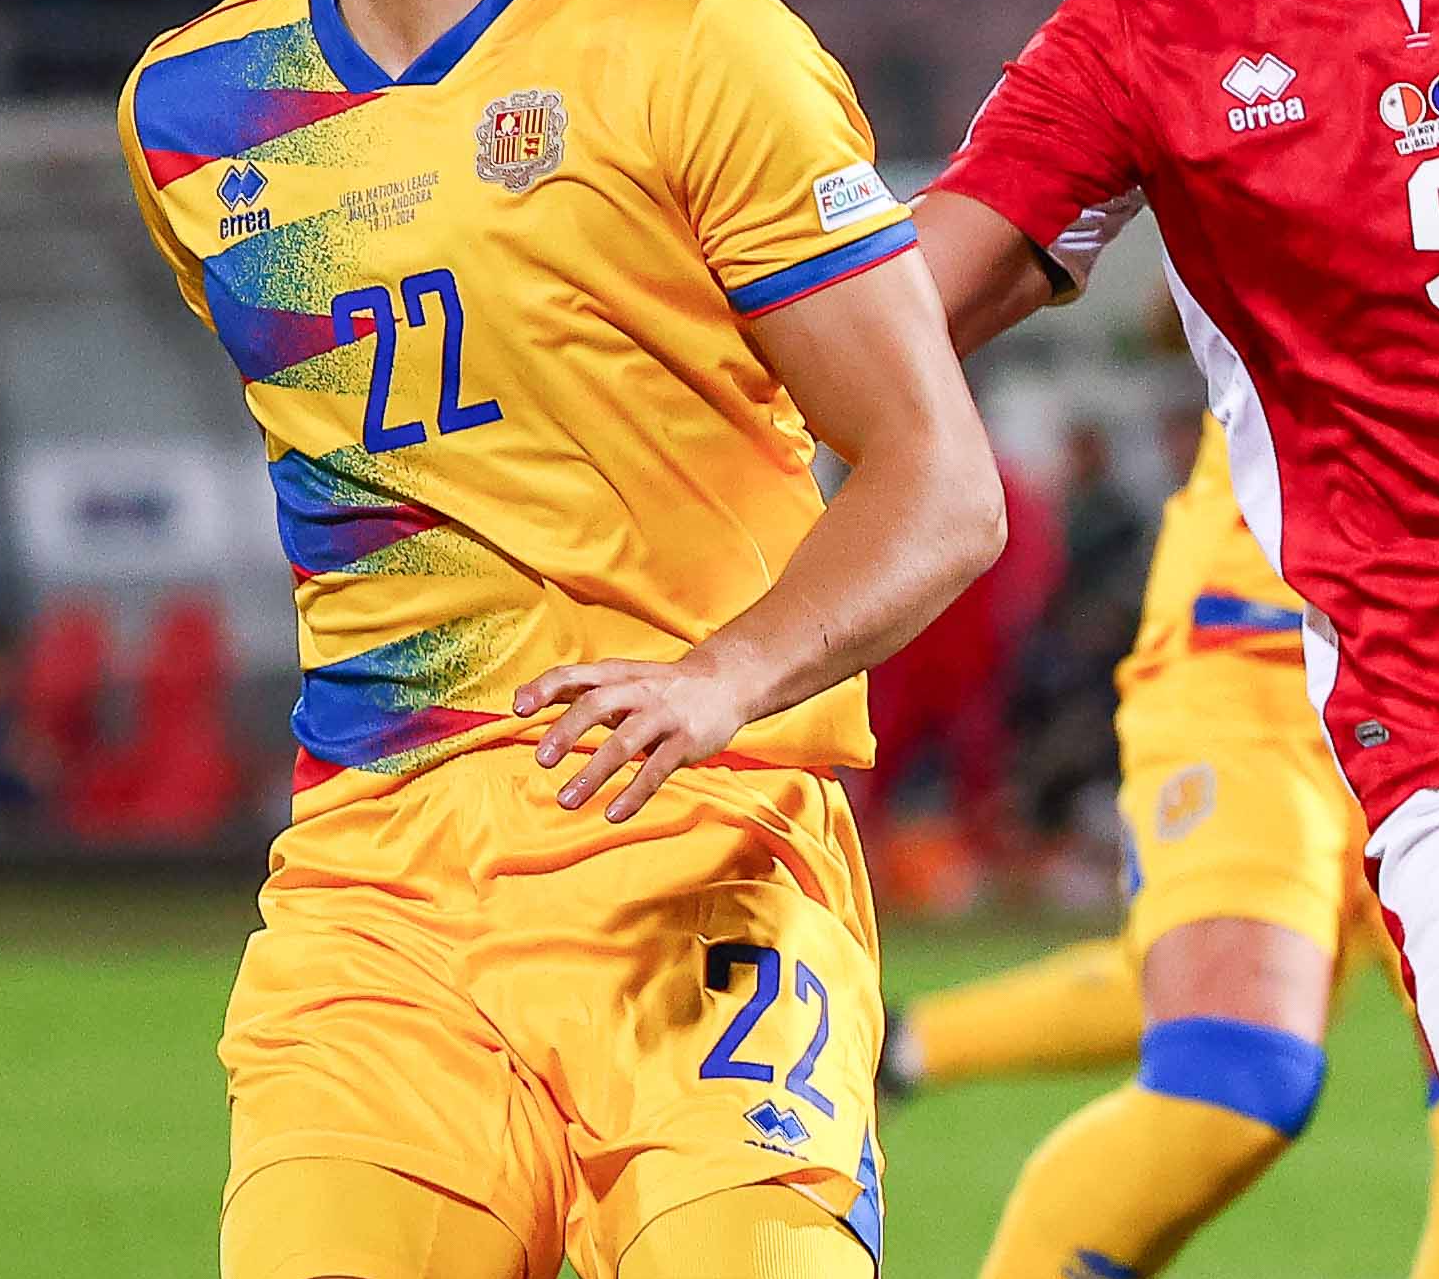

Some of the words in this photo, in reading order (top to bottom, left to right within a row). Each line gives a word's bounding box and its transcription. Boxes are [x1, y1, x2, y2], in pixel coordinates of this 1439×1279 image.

[220, 207, 271, 239] errea
[339, 190, 364, 208] UEFA
[365, 181, 405, 204] NATIONS
[407, 169, 440, 192] LEAGUE
[331, 268, 504, 455] 22
[698, 943, 835, 1121] 22
